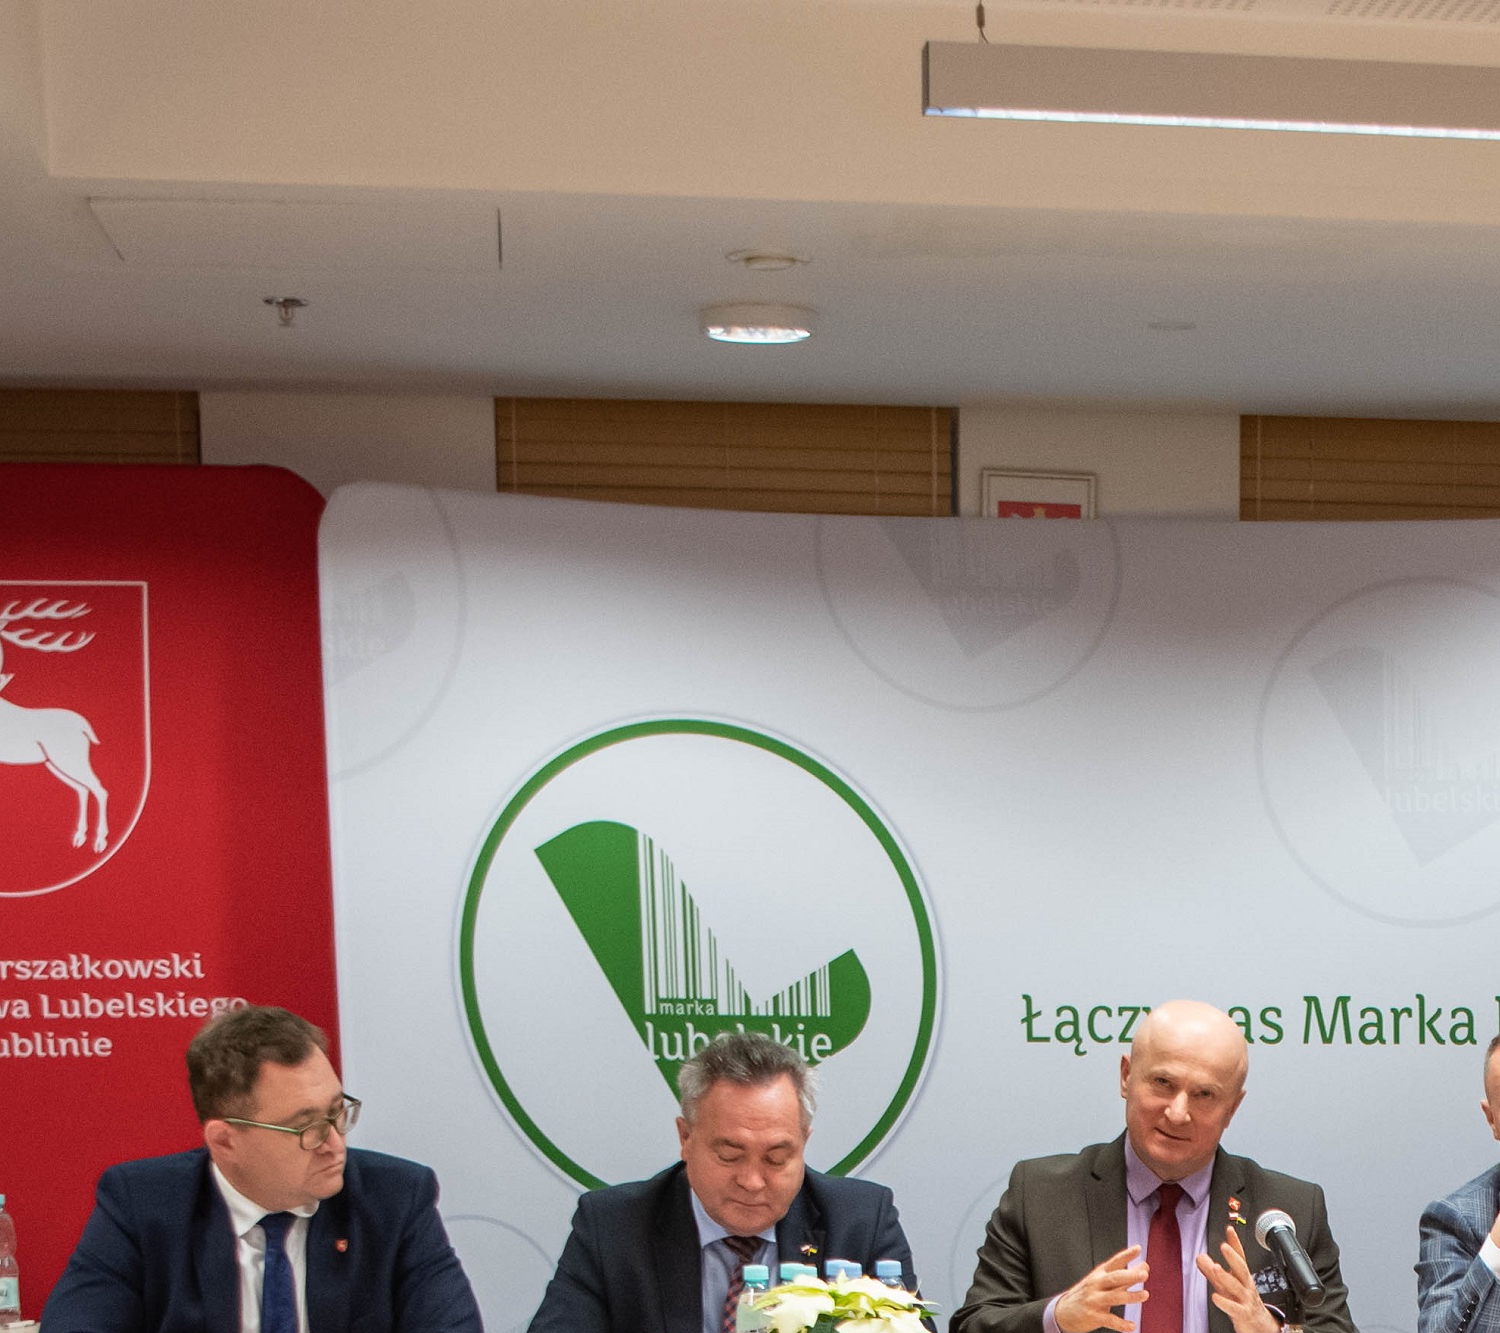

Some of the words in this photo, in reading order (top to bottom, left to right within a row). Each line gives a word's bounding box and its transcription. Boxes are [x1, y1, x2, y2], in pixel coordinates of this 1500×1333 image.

[659, 1002, 715, 1016] marka
[1020, 993, 1151, 1056] Łącz
[1227, 1006, 1284, 1045] as
[1303, 993, 1477, 1045] Marka
